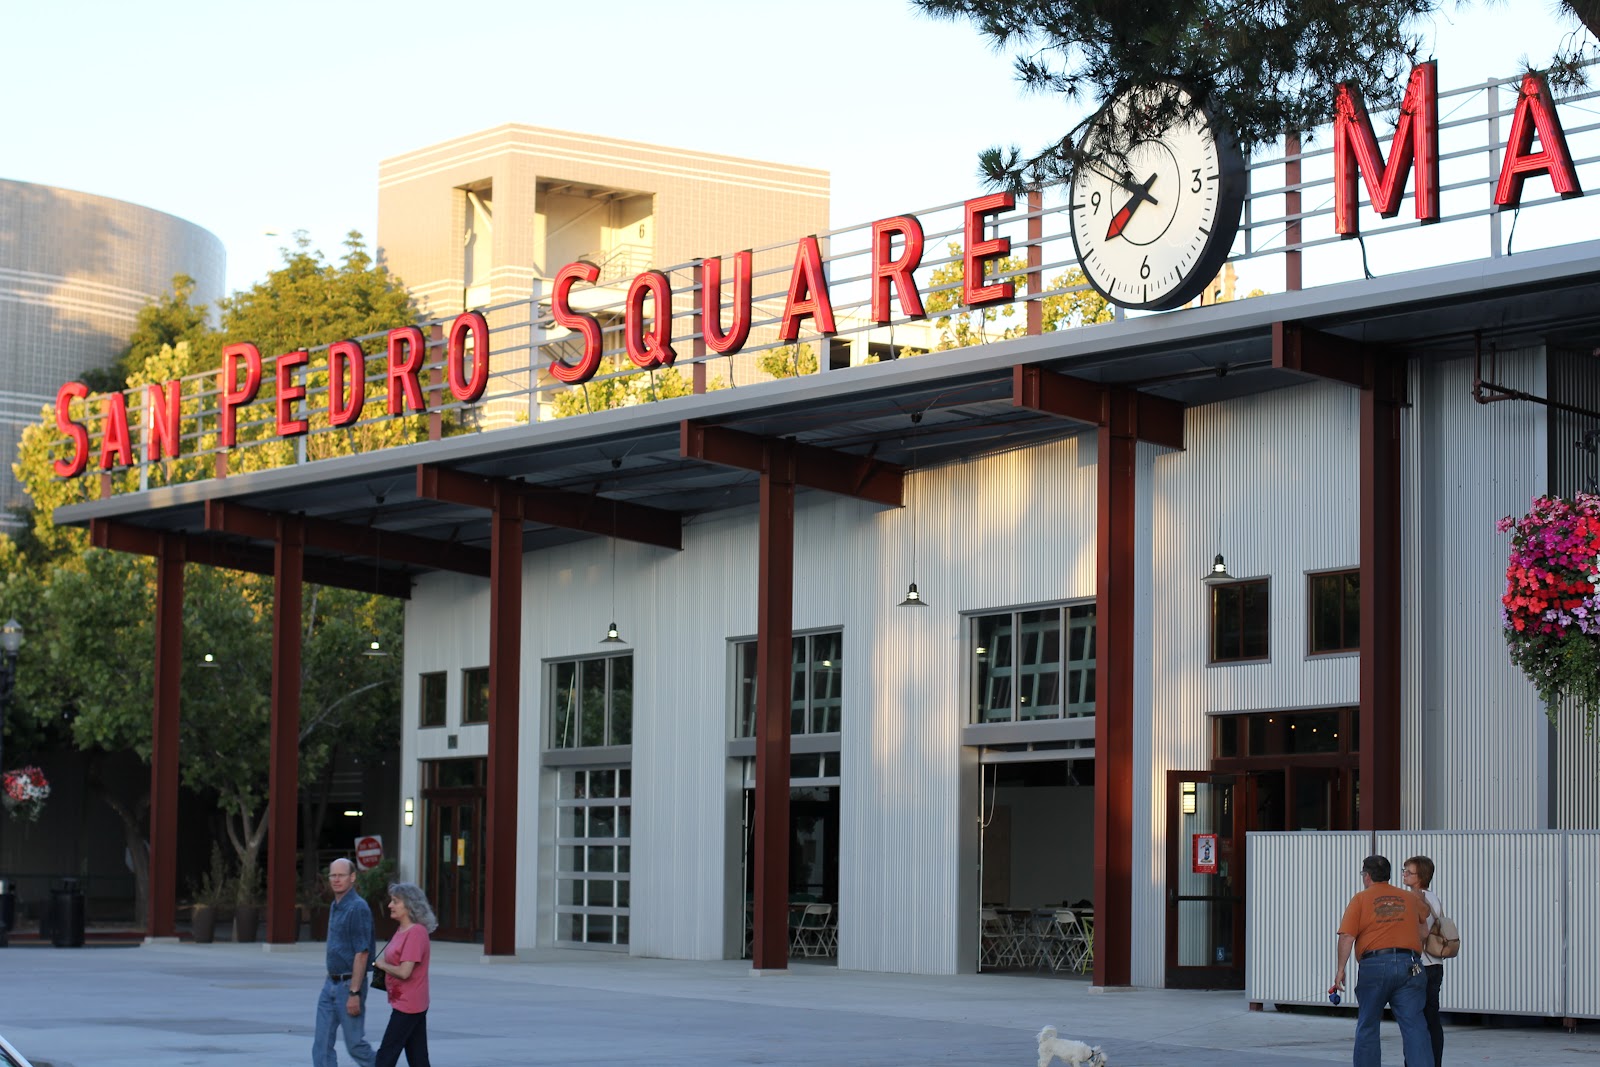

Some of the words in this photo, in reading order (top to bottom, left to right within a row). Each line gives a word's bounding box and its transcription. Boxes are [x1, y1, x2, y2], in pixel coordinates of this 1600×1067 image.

[1191, 168, 1202, 194] 3
[1091, 191, 1101, 216] 9
[639, 224, 645, 238] 6
[1140, 255, 1151, 280] 6
[53, 379, 181, 478] SAN
[222, 310, 489, 448] PEDRO
[548, 191, 1016, 385] SQUARE
